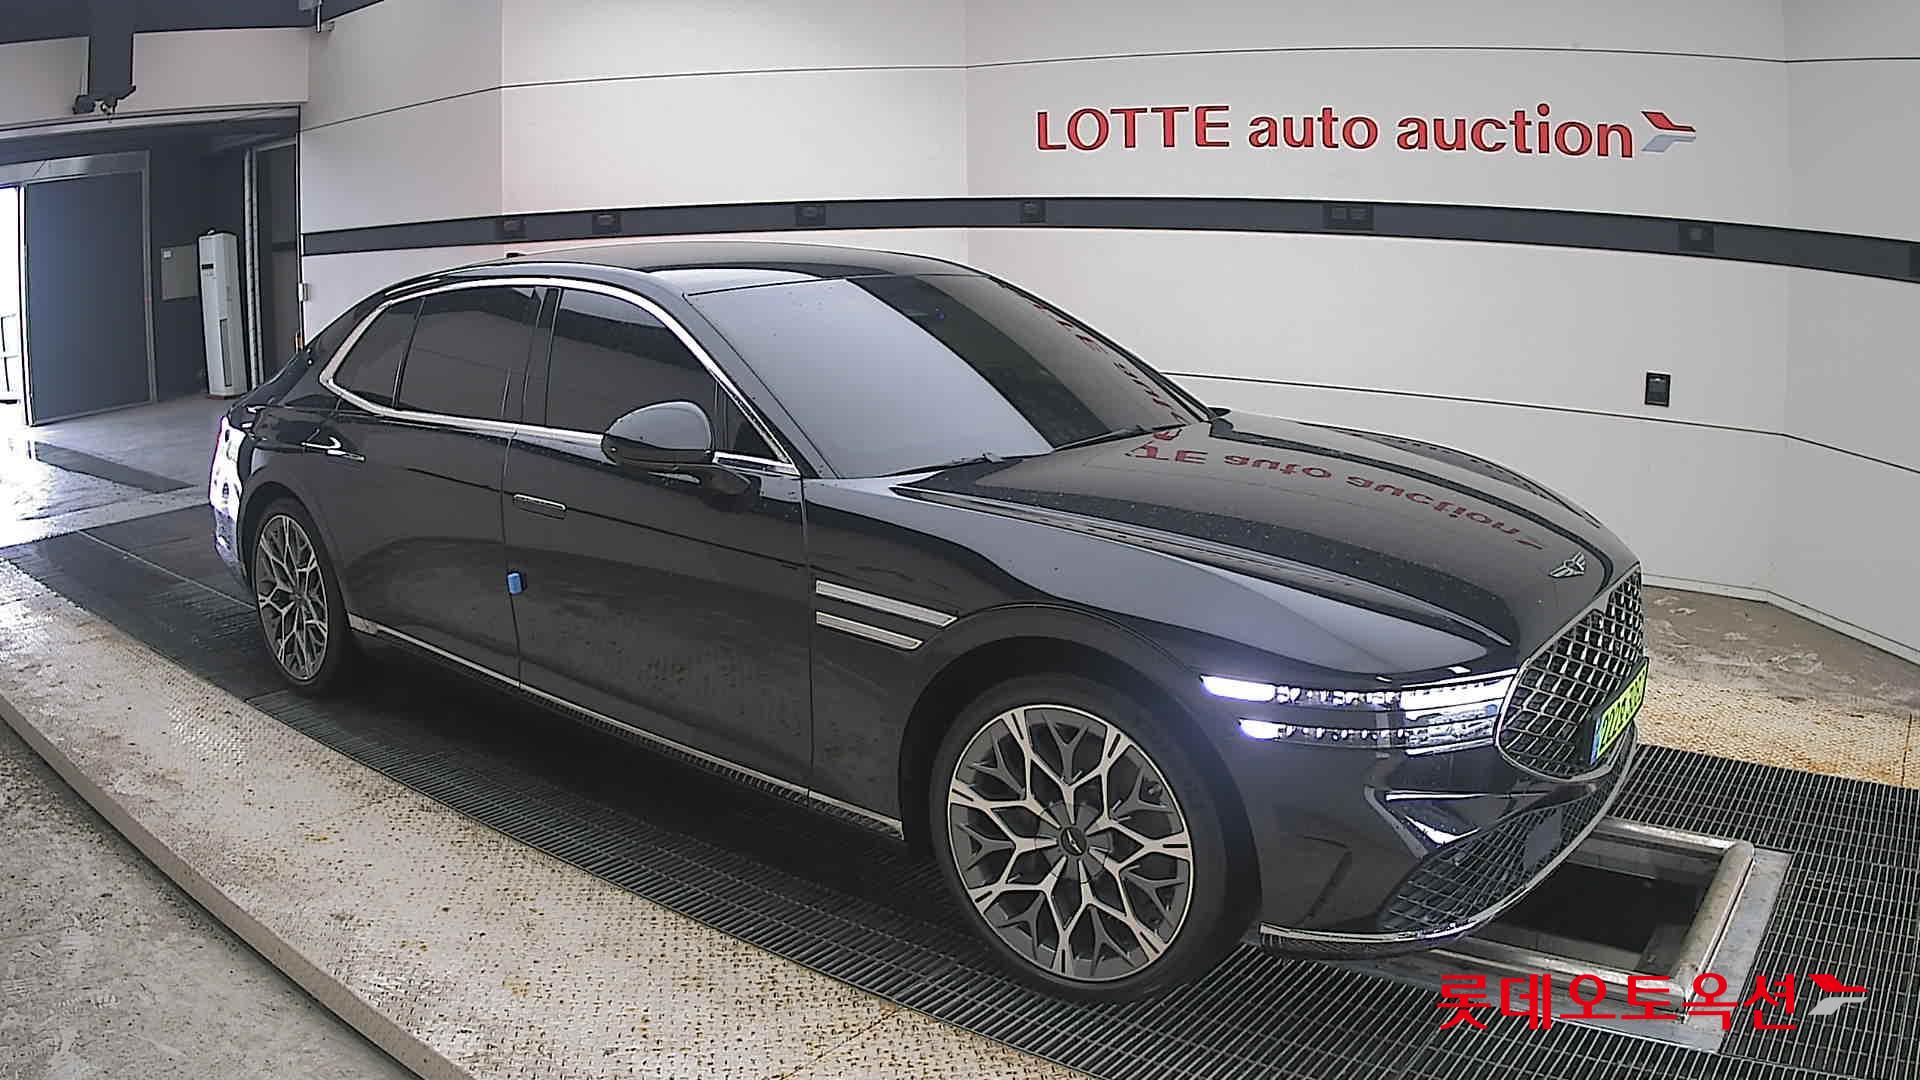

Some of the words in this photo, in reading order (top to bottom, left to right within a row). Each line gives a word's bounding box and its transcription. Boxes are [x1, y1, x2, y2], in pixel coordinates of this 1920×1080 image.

[1036, 104, 1230, 151] LOTTE
[1247, 107, 1379, 150] auto
[1396, 104, 1635, 159] auction
